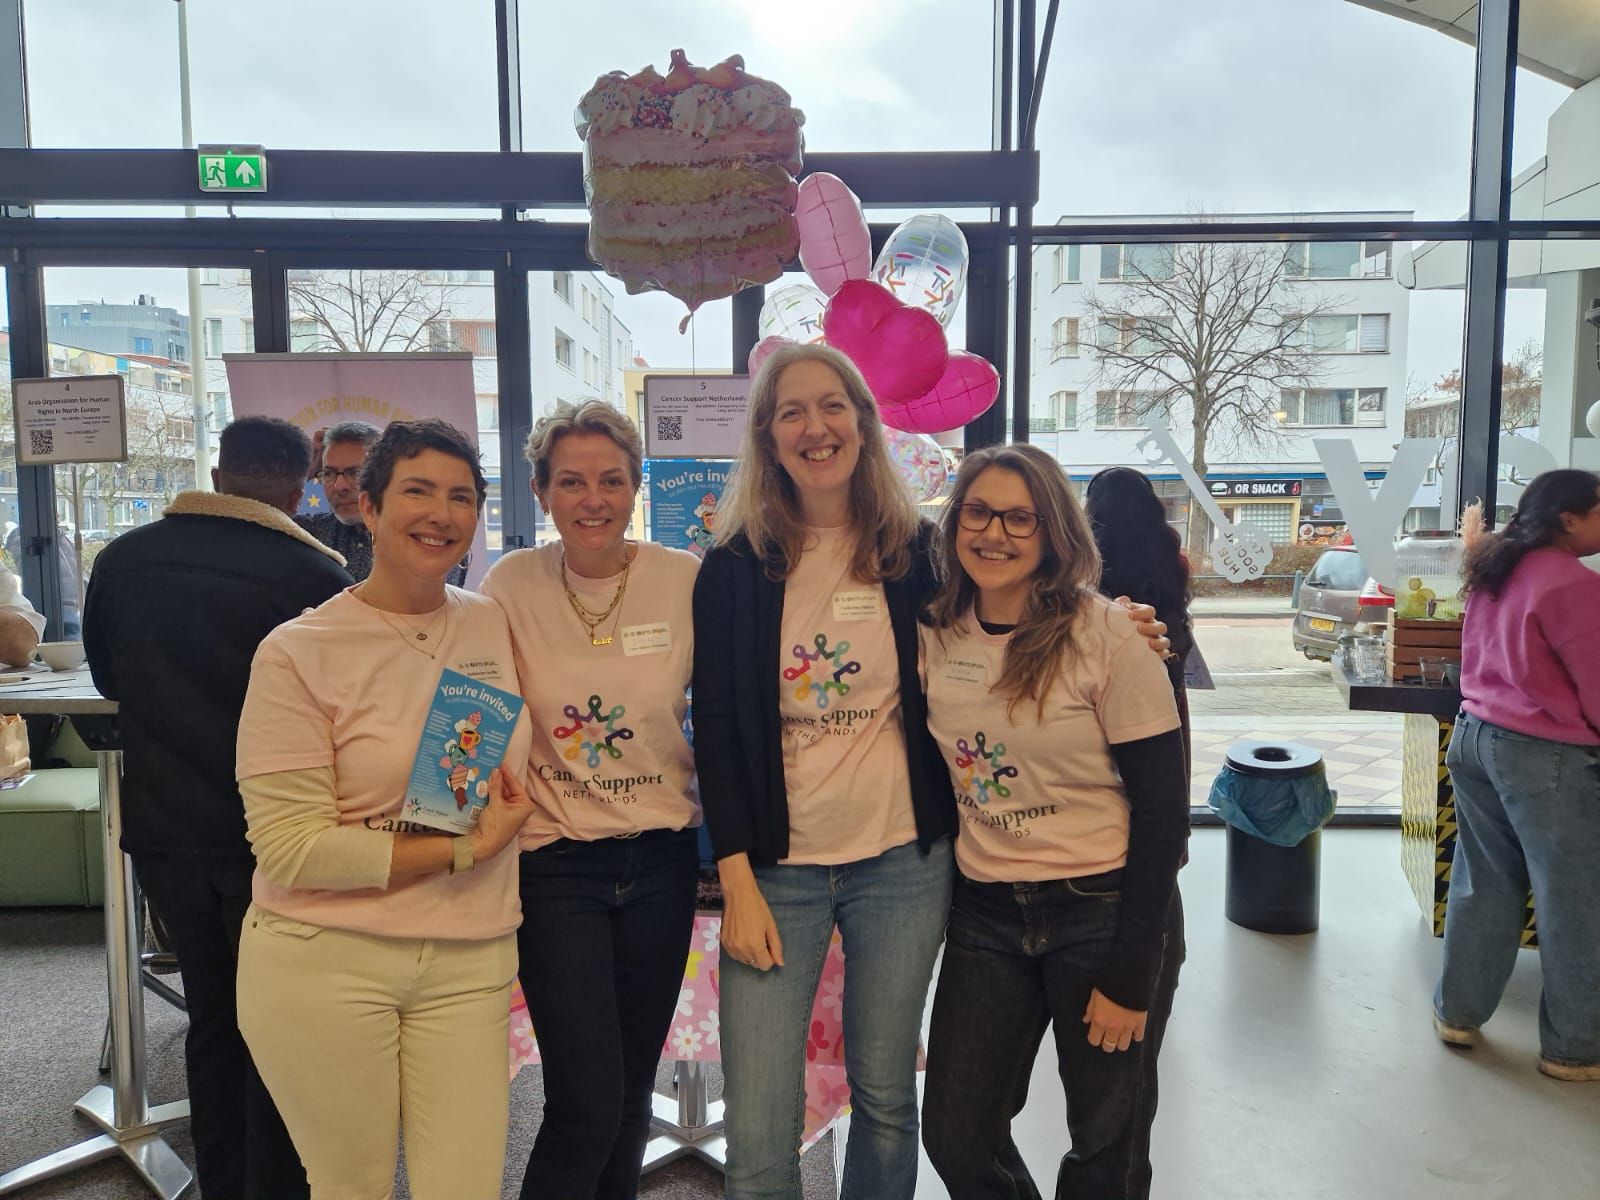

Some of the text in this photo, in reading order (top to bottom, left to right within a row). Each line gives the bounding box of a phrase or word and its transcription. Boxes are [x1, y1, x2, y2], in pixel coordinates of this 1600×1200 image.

[64, 383, 70, 392] 4
[700, 382, 706, 390] 5
[344, 396, 389, 416] HUMAN
[683, 395, 707, 403] Support
[37, 408, 55, 416] Rights
[62, 407, 79, 415] North
[80, 407, 101, 415] Europe
[657, 470, 704, 493] You're
[1235, 483, 1287, 494] OR SNACK
[440, 684, 479, 698] You're
[479, 687, 516, 722] invited
[820, 708, 878, 729] Sppor
[592, 774, 664, 795] Support
[982, 804, 1058, 831] upport
